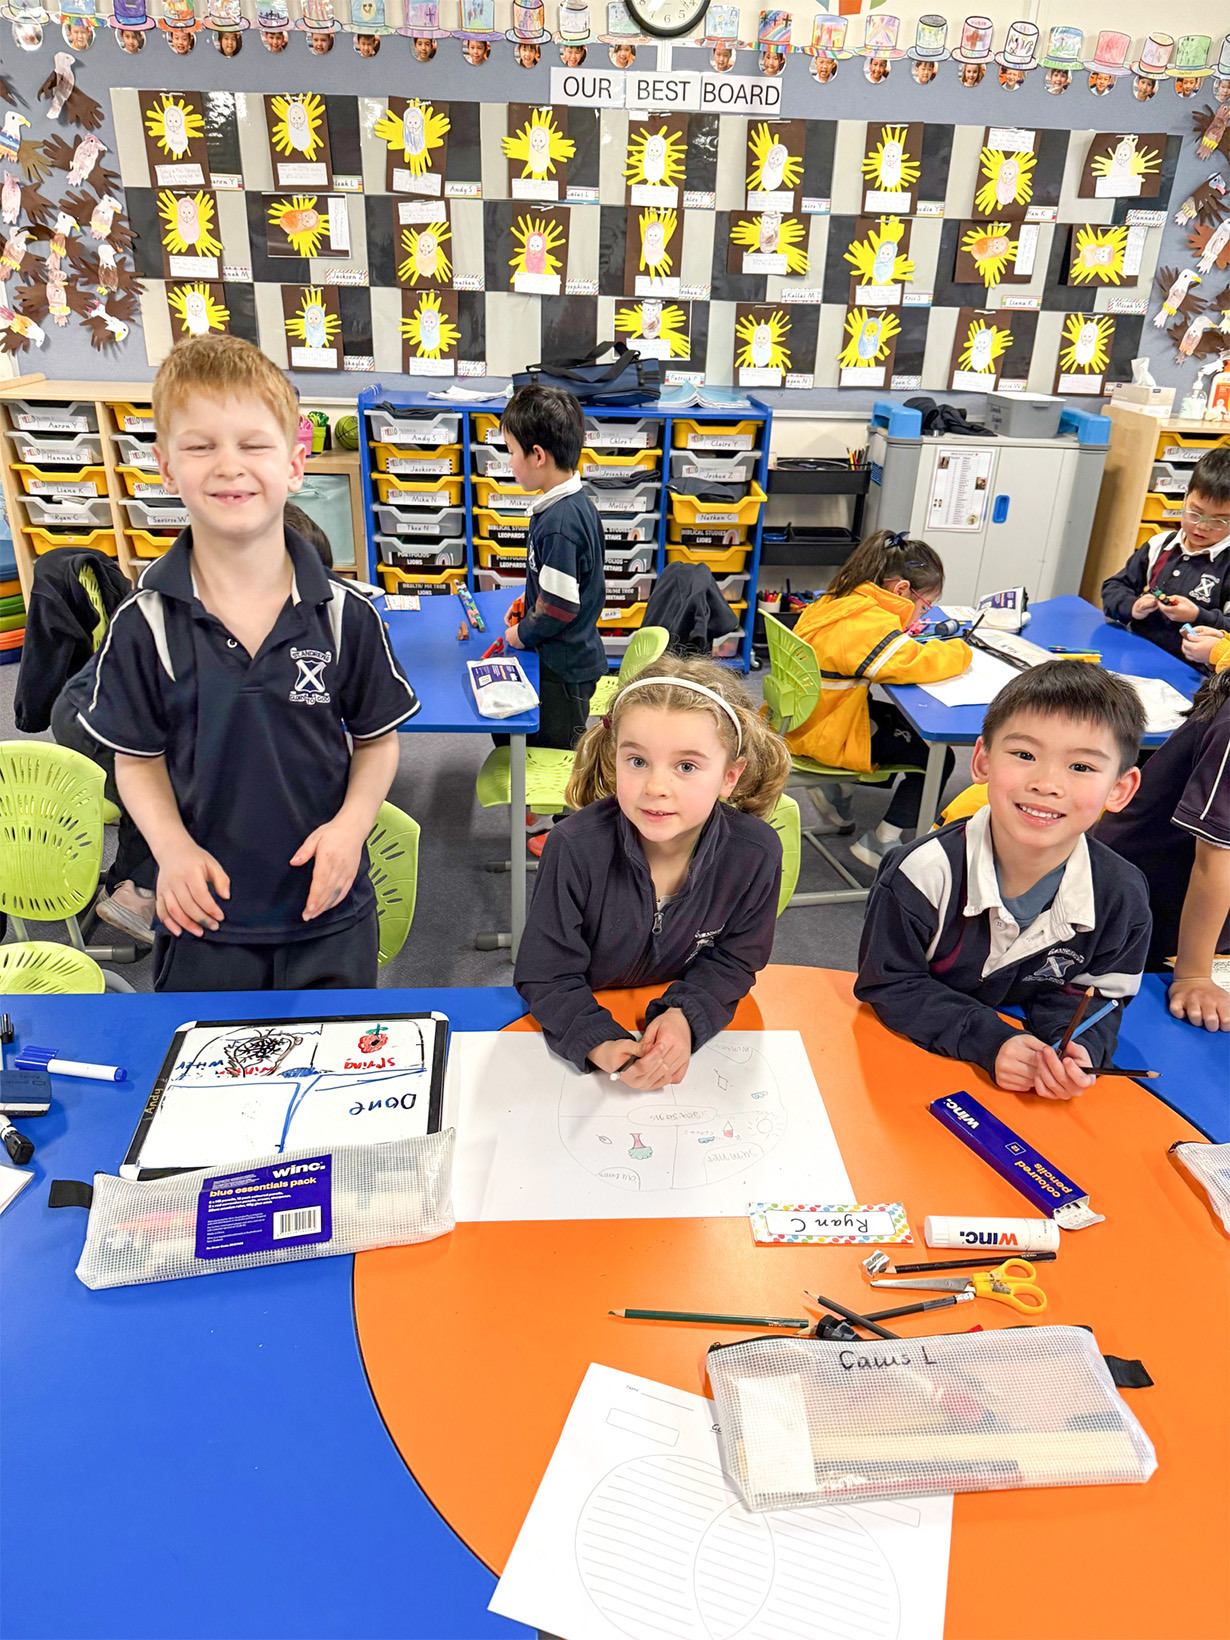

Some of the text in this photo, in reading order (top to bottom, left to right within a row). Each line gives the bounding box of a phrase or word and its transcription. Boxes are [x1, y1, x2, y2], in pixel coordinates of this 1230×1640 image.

[663, 14, 671, 24] 6
[678, 9, 686, 19] 5
[562, 75, 781, 107] OUR BEST BOARD
[449, 185, 473, 195] Andy S
[48, 421, 78, 431] Aaron Y
[411, 434, 437, 444] Andy S
[732, 440, 739, 448] Y
[47, 453, 75, 461] Hannah
[438, 465, 444, 473] Z
[703, 471, 734, 479] Joshua Z
[57, 486, 85, 494] Liana K
[608, 500, 636, 511] Molly A
[54, 513, 72, 523] Ryan
[178, 515, 187, 523] W
[700, 513, 733, 521] Nathan C
[422, 524, 429, 532] N
[497, 531, 526, 540] LEOPARDS
[695, 536, 713, 544] LIONS
[406, 558, 423, 566] LIONS
[498, 561, 527, 569] LEOPARDS
[416, 588, 433, 596] LIONS
[145, 1087, 165, 1116] Andy
[348, 1092, 417, 1117] Done
[942, 1097, 981, 1130] winc.
[272, 1161, 327, 1179] winc.
[1014, 1160, 1062, 1199] coloured
[1033, 1162, 1074, 1195] pencils
[209, 1188, 234, 1199] blue
[234, 1179, 290, 1195] essentials
[289, 1176, 318, 1189] pack
[789, 1213, 868, 1234] Ryan C
[959, 1230, 1019, 1248] winc.
[919, 1345, 938, 1367] L
